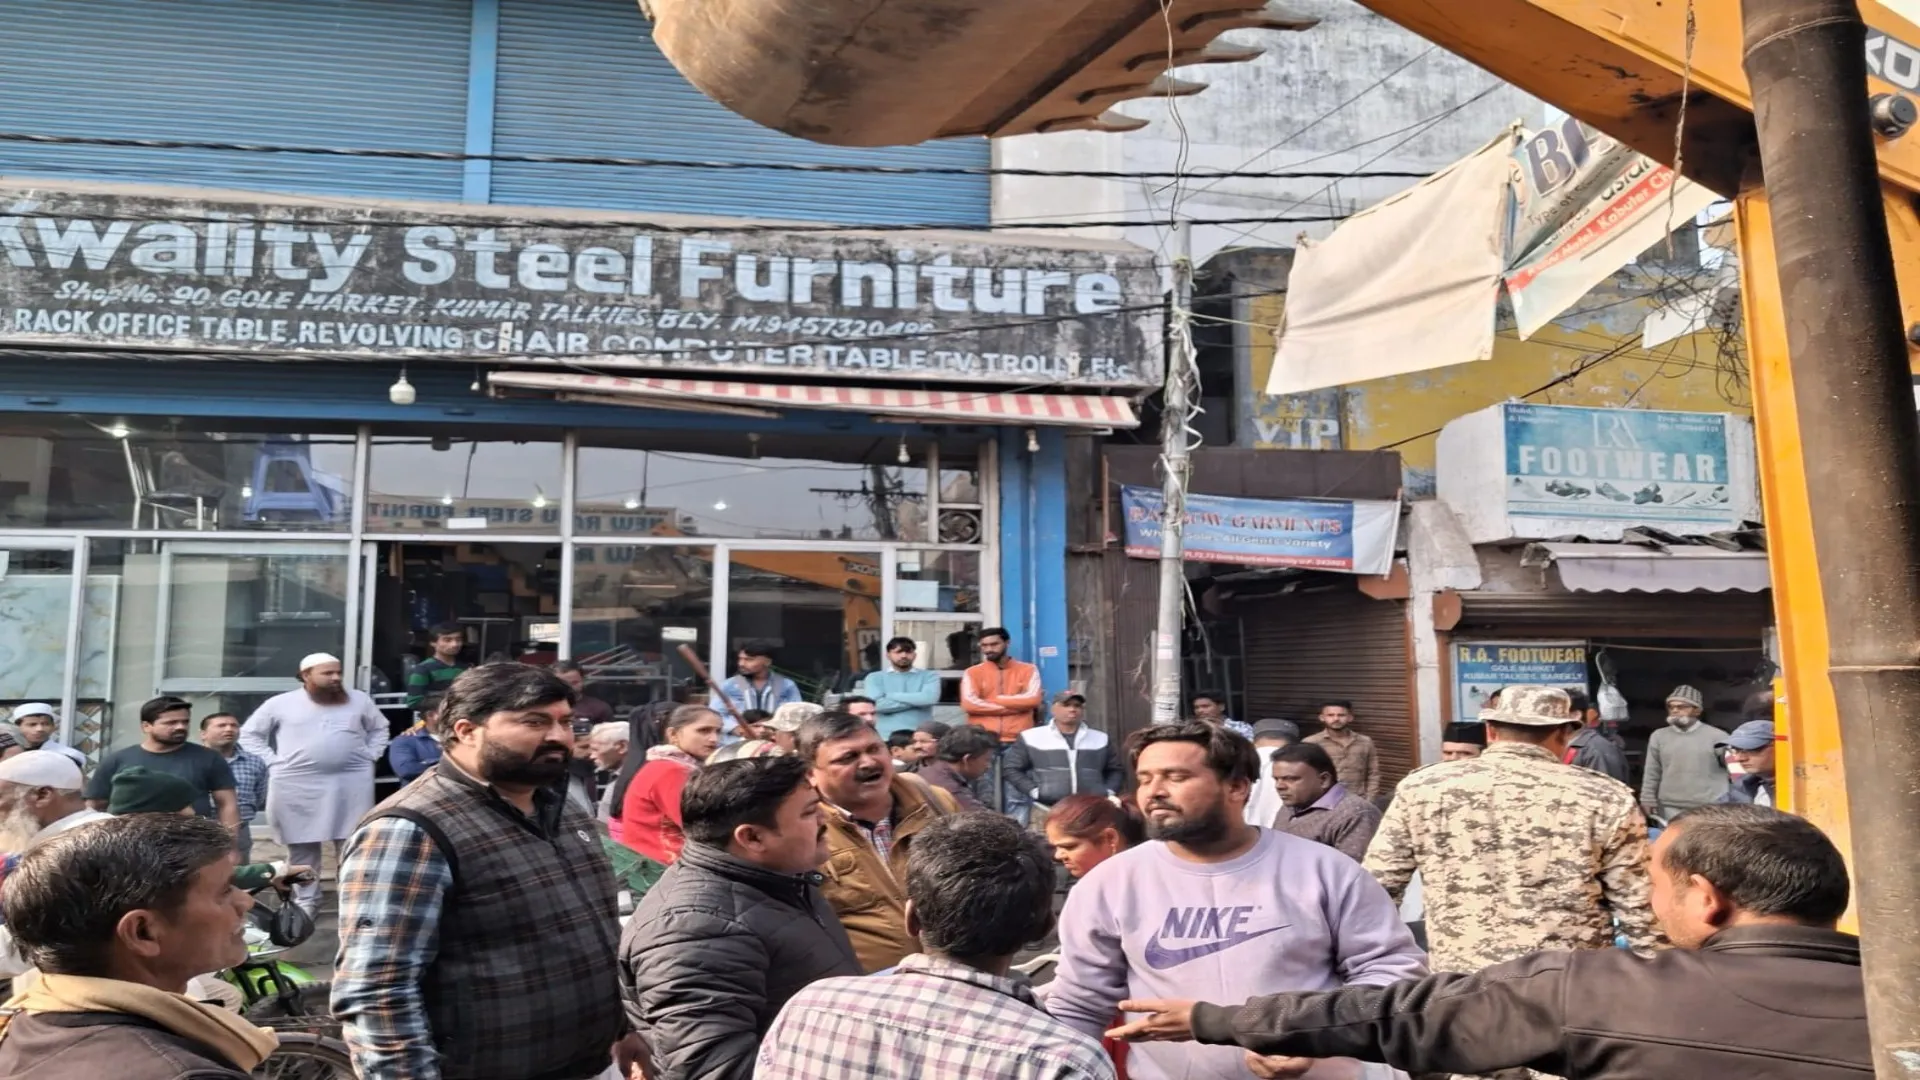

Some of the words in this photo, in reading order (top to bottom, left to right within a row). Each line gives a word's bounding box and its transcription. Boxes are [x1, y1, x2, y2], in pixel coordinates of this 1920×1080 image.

[402, 226, 652, 296] Steel
[680, 238, 1122, 316] Furniture
[220, 289, 295, 309] GOLE
[430, 298, 532, 321] KUMAR
[1252, 418, 1339, 450] VIP
[1519, 444, 1717, 482] FOOTWEAR
[1232, 513, 1343, 535] GARMENTS
[1460, 647, 1493, 663] R.A.
[1498, 647, 1586, 663] FOOTWEAR
[1160, 905, 1254, 939] NIKE
